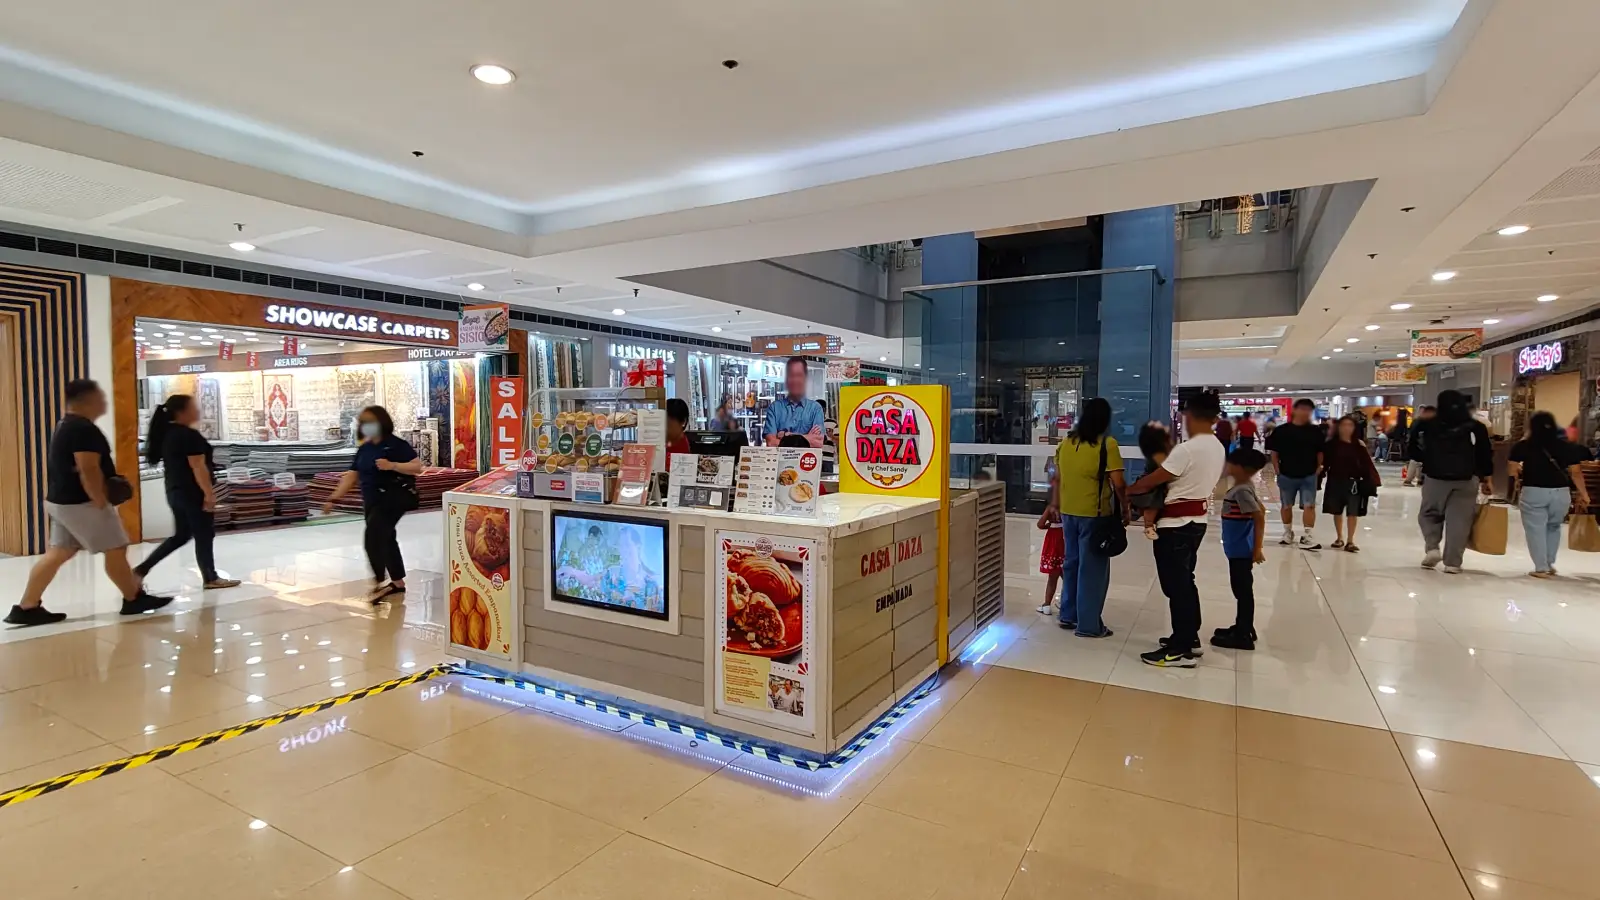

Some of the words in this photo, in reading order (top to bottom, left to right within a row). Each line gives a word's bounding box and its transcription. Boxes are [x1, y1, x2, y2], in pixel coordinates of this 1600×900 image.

[265, 304, 379, 332] SHOWCASE
[380, 321, 451, 341] CARPETS
[274, 358, 290, 367] AREA
[290, 357, 308, 366] RUGS
[408, 348, 433, 359] HOTEL
[497, 381, 518, 465] SALE
[855, 408, 920, 435] CASA
[856, 437, 921, 465] DAZA
[890, 466, 908, 474] Sandy
[861, 546, 890, 577] CASA
[898, 535, 922, 563] DAZA
[463, 562, 486, 590] Assorted
[876, 584, 912, 614] EMPANADA
